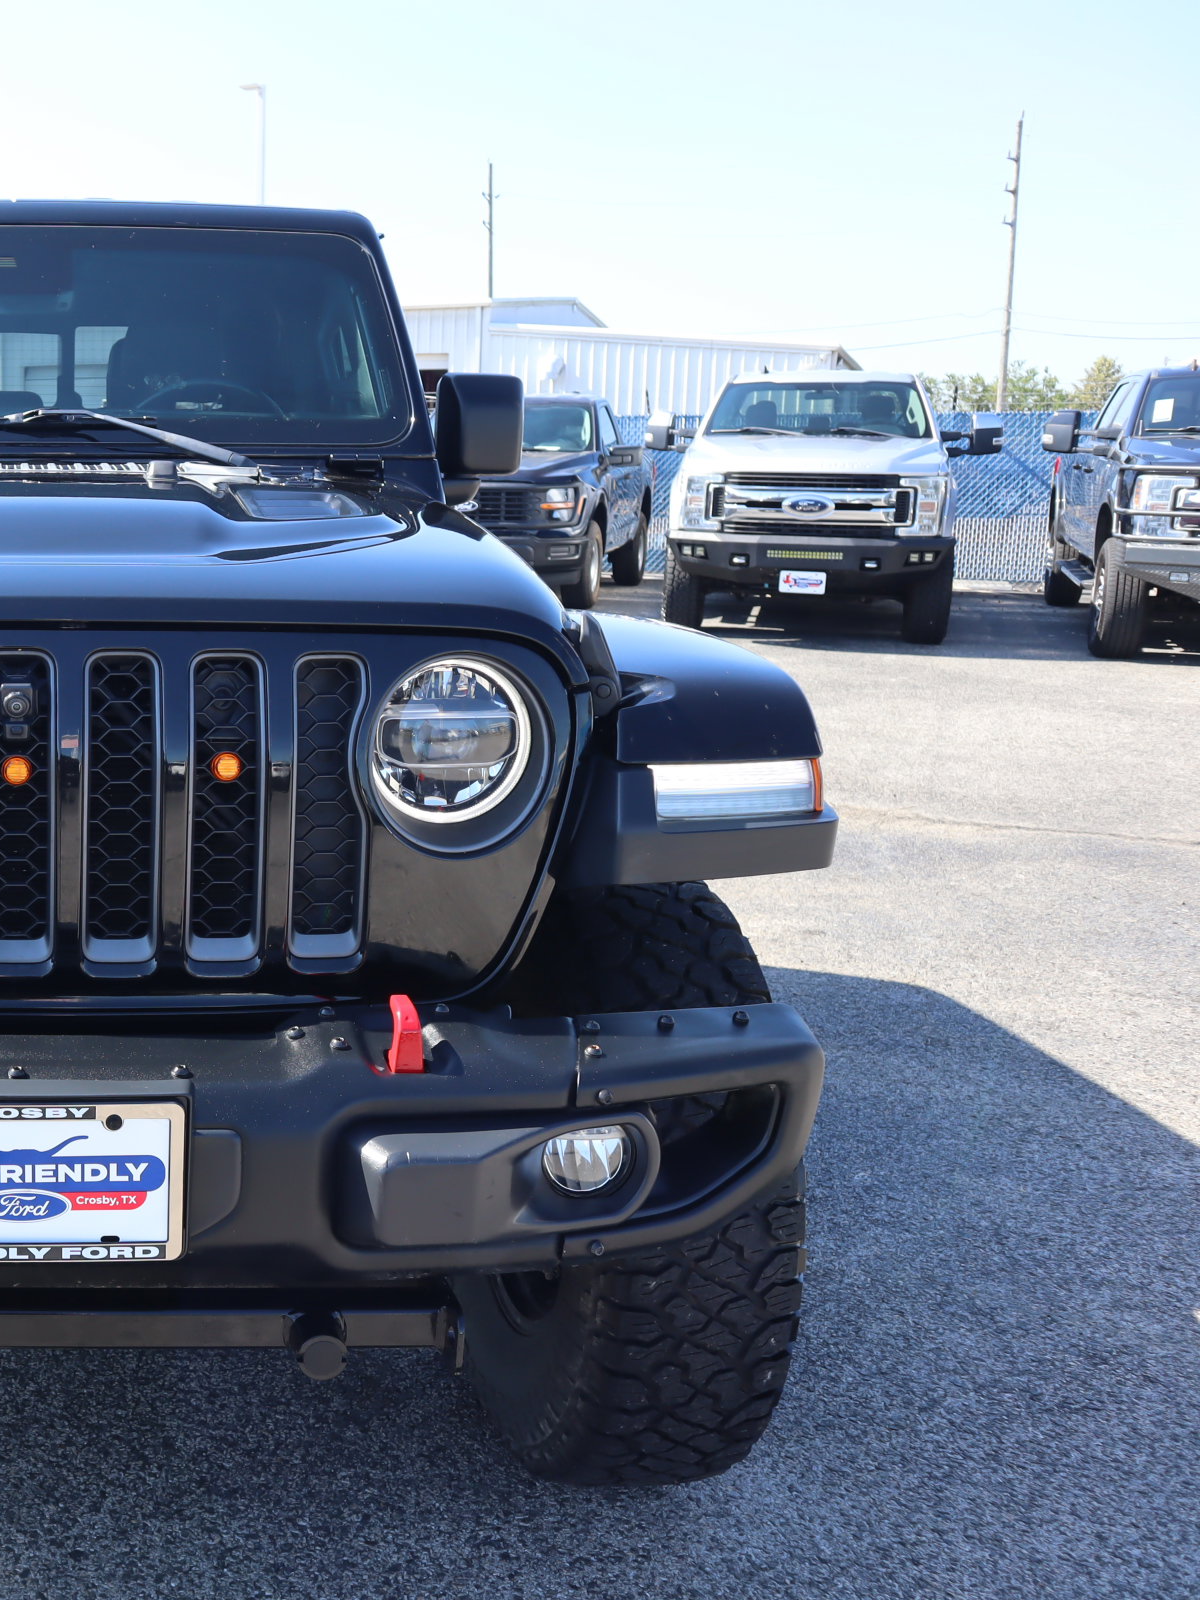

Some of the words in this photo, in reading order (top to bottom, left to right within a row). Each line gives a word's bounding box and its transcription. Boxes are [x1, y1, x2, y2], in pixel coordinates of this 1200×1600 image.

[75, 1195, 119, 1206] Crosby,
[120, 1195, 137, 1204] TX
[61, 1246, 160, 1258] FORD
